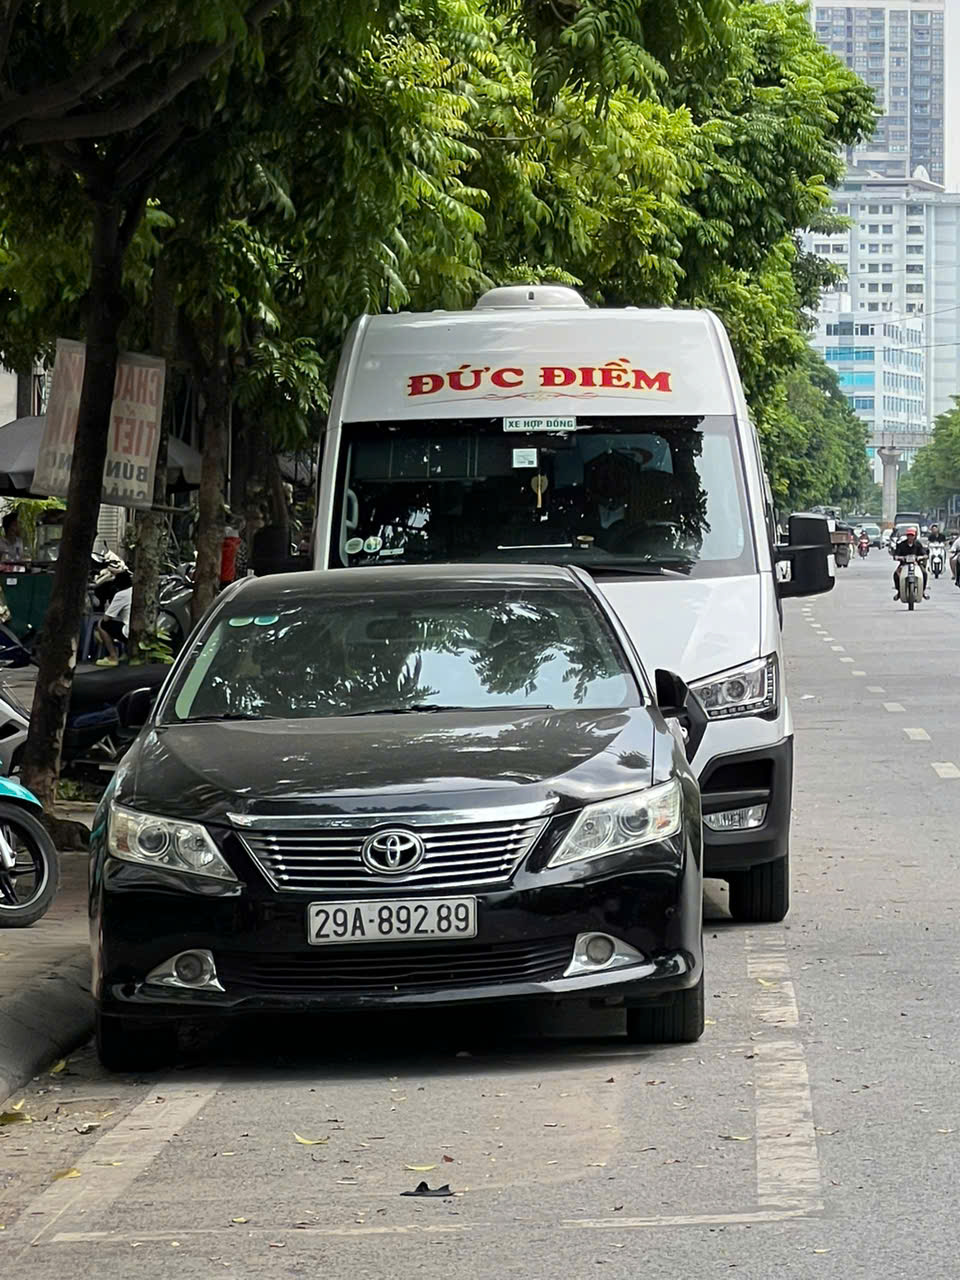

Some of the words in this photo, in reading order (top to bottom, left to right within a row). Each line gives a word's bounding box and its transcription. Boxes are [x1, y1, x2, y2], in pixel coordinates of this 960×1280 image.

[407, 364, 524, 396] ĐỨC
[539, 358, 673, 392] ĐIỀM
[508, 420, 520, 428] XE
[523, 419, 543, 429] HỢP
[314, 903, 470, 939] 29A-892.89
